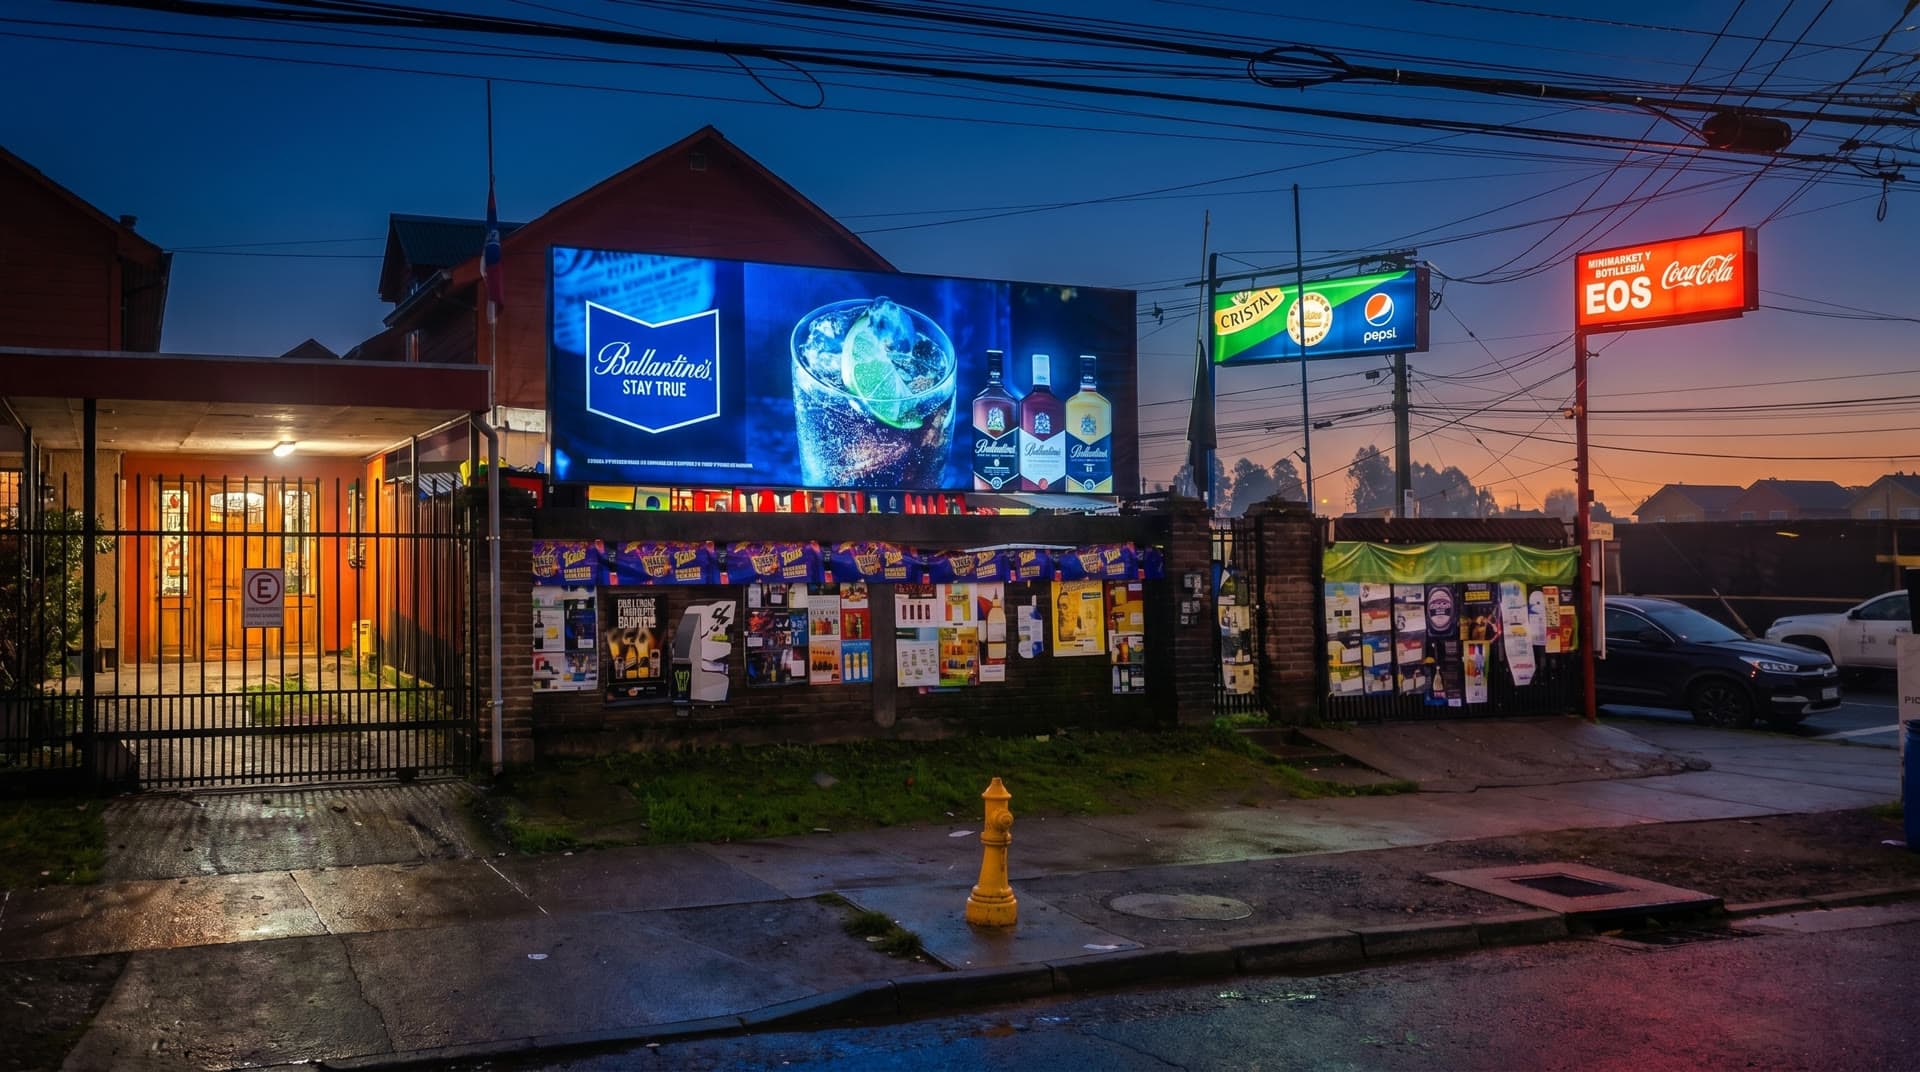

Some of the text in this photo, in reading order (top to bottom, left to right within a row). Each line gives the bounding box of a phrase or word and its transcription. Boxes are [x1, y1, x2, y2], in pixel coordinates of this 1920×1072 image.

[1588, 251, 1651, 269] MINIMARKET Y
[1595, 263, 1646, 278] BOTILLERÍA
[1661, 253, 1737, 290] Coca-Cola
[1586, 276, 1652, 315] EOS
[1220, 291, 1279, 329] CRISTAL
[1363, 327, 1397, 344] pepsi
[594, 341, 712, 380] Ballantine's
[622, 379, 687, 397] STAY TRUE
[257, 578, 272, 598] E
